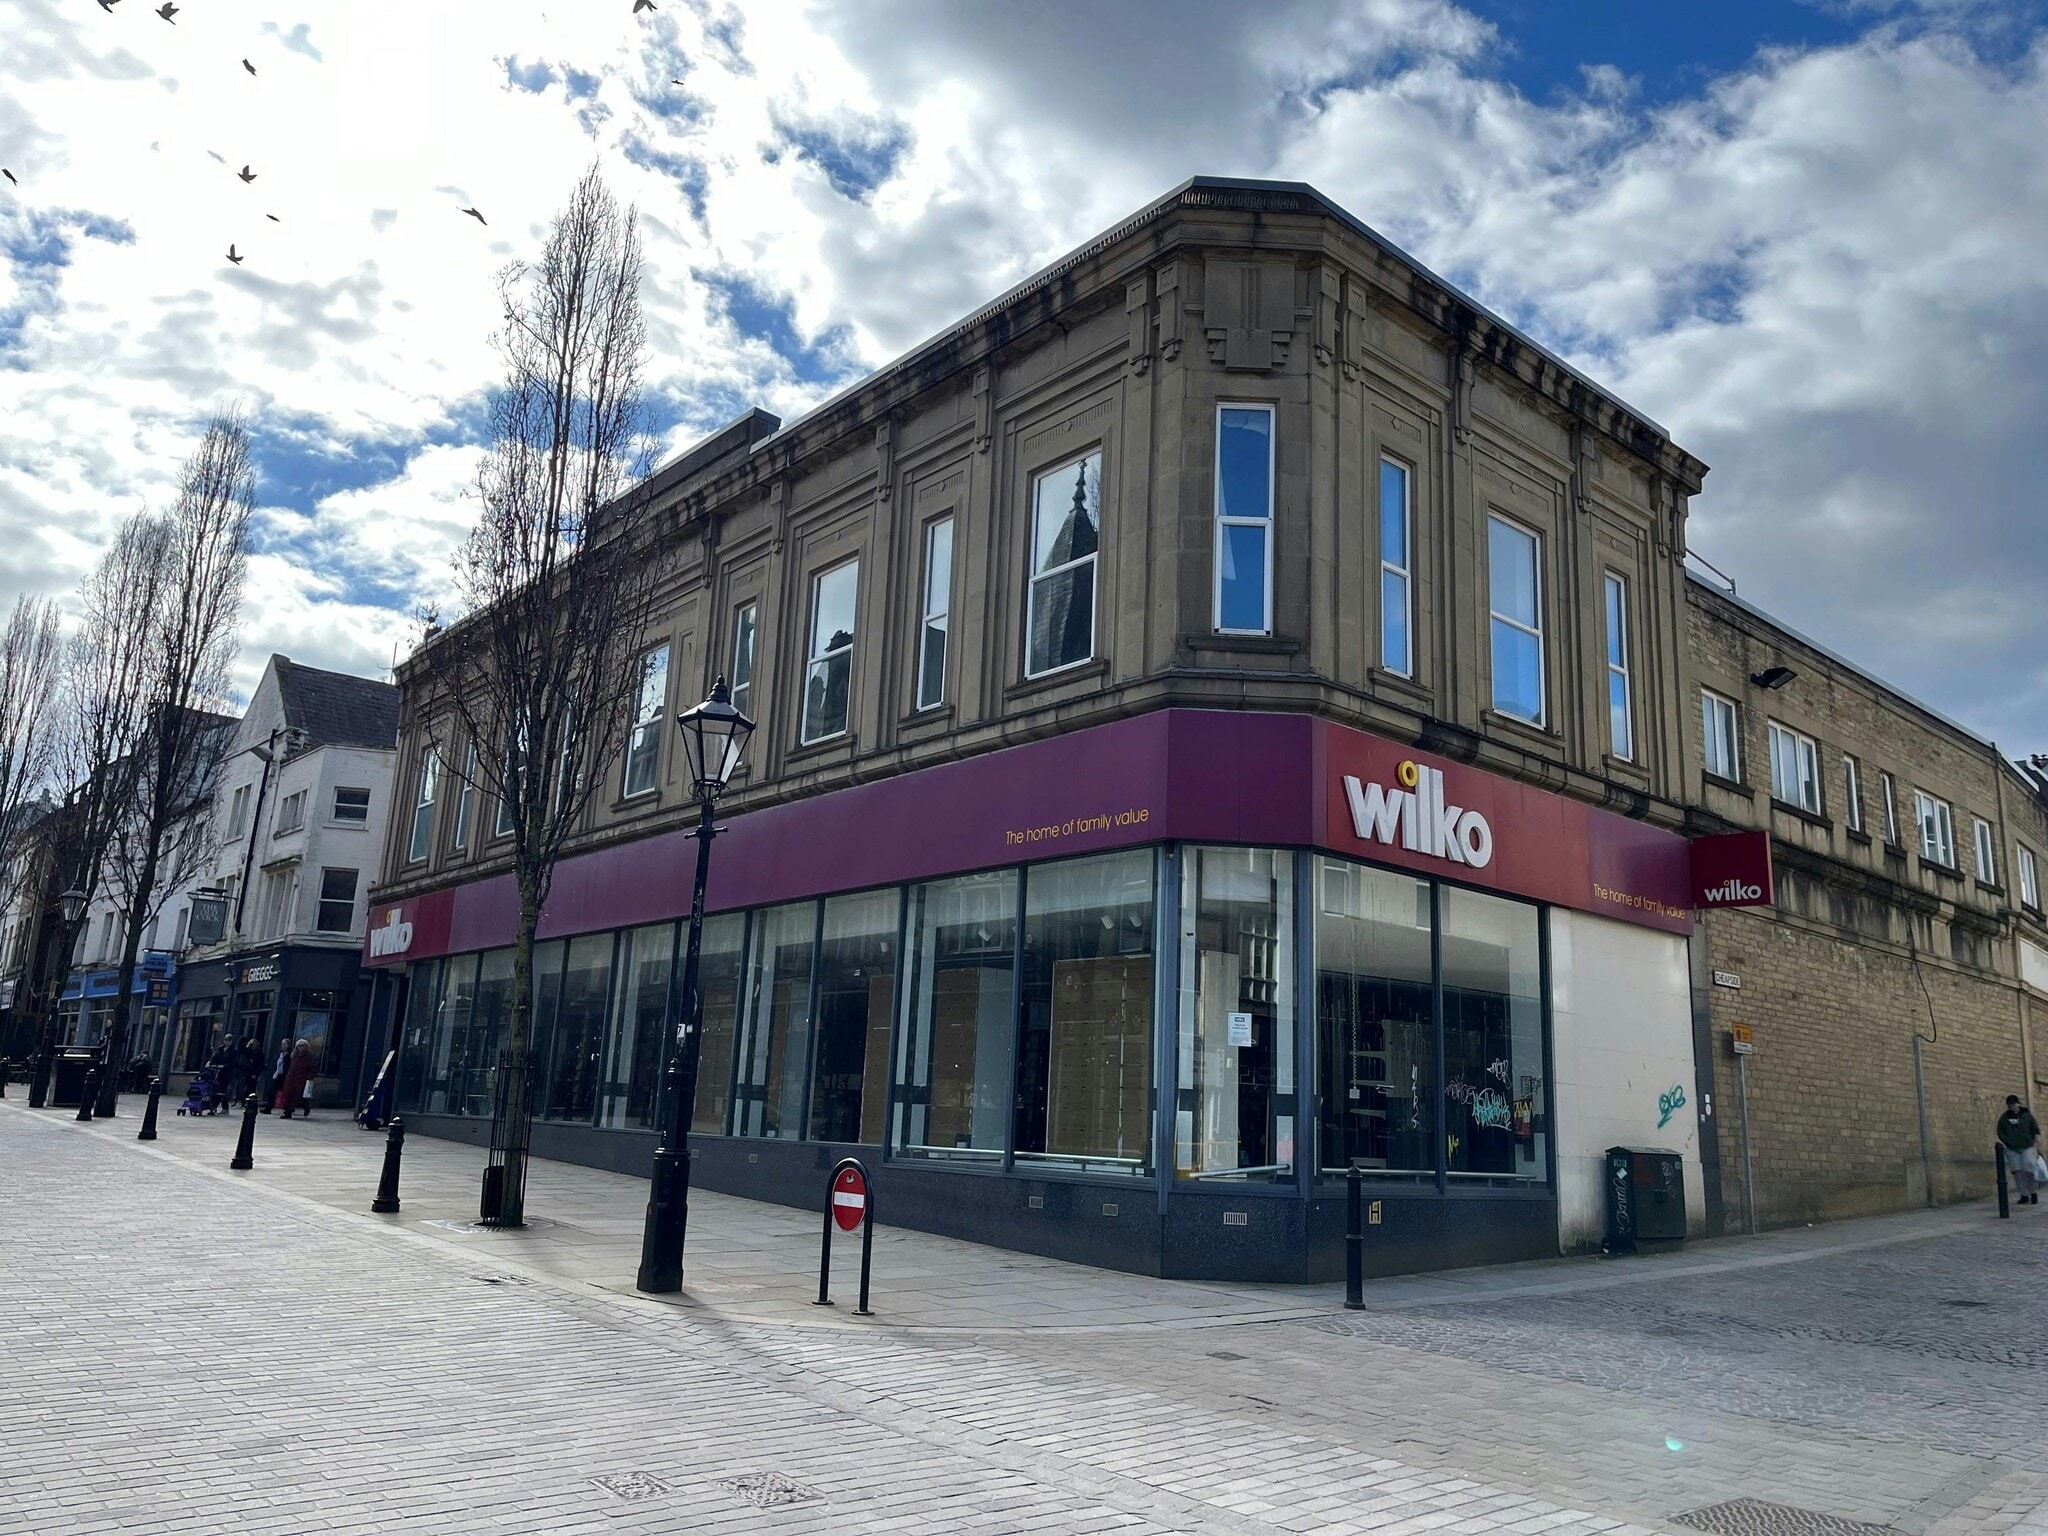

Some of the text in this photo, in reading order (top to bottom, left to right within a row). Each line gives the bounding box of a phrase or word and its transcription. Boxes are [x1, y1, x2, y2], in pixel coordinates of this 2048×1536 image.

[1006, 808, 1149, 845] The home of family value
[1344, 760, 1493, 869] wilko
[1593, 883, 1686, 920] The home of family value
[1704, 879, 1762, 902] wilko
[196, 914, 220, 922] COCK
[370, 908, 413, 958] wilko
[248, 965, 274, 982] GREGGS
[1715, 973, 1740, 986] CHEAPSIDE
